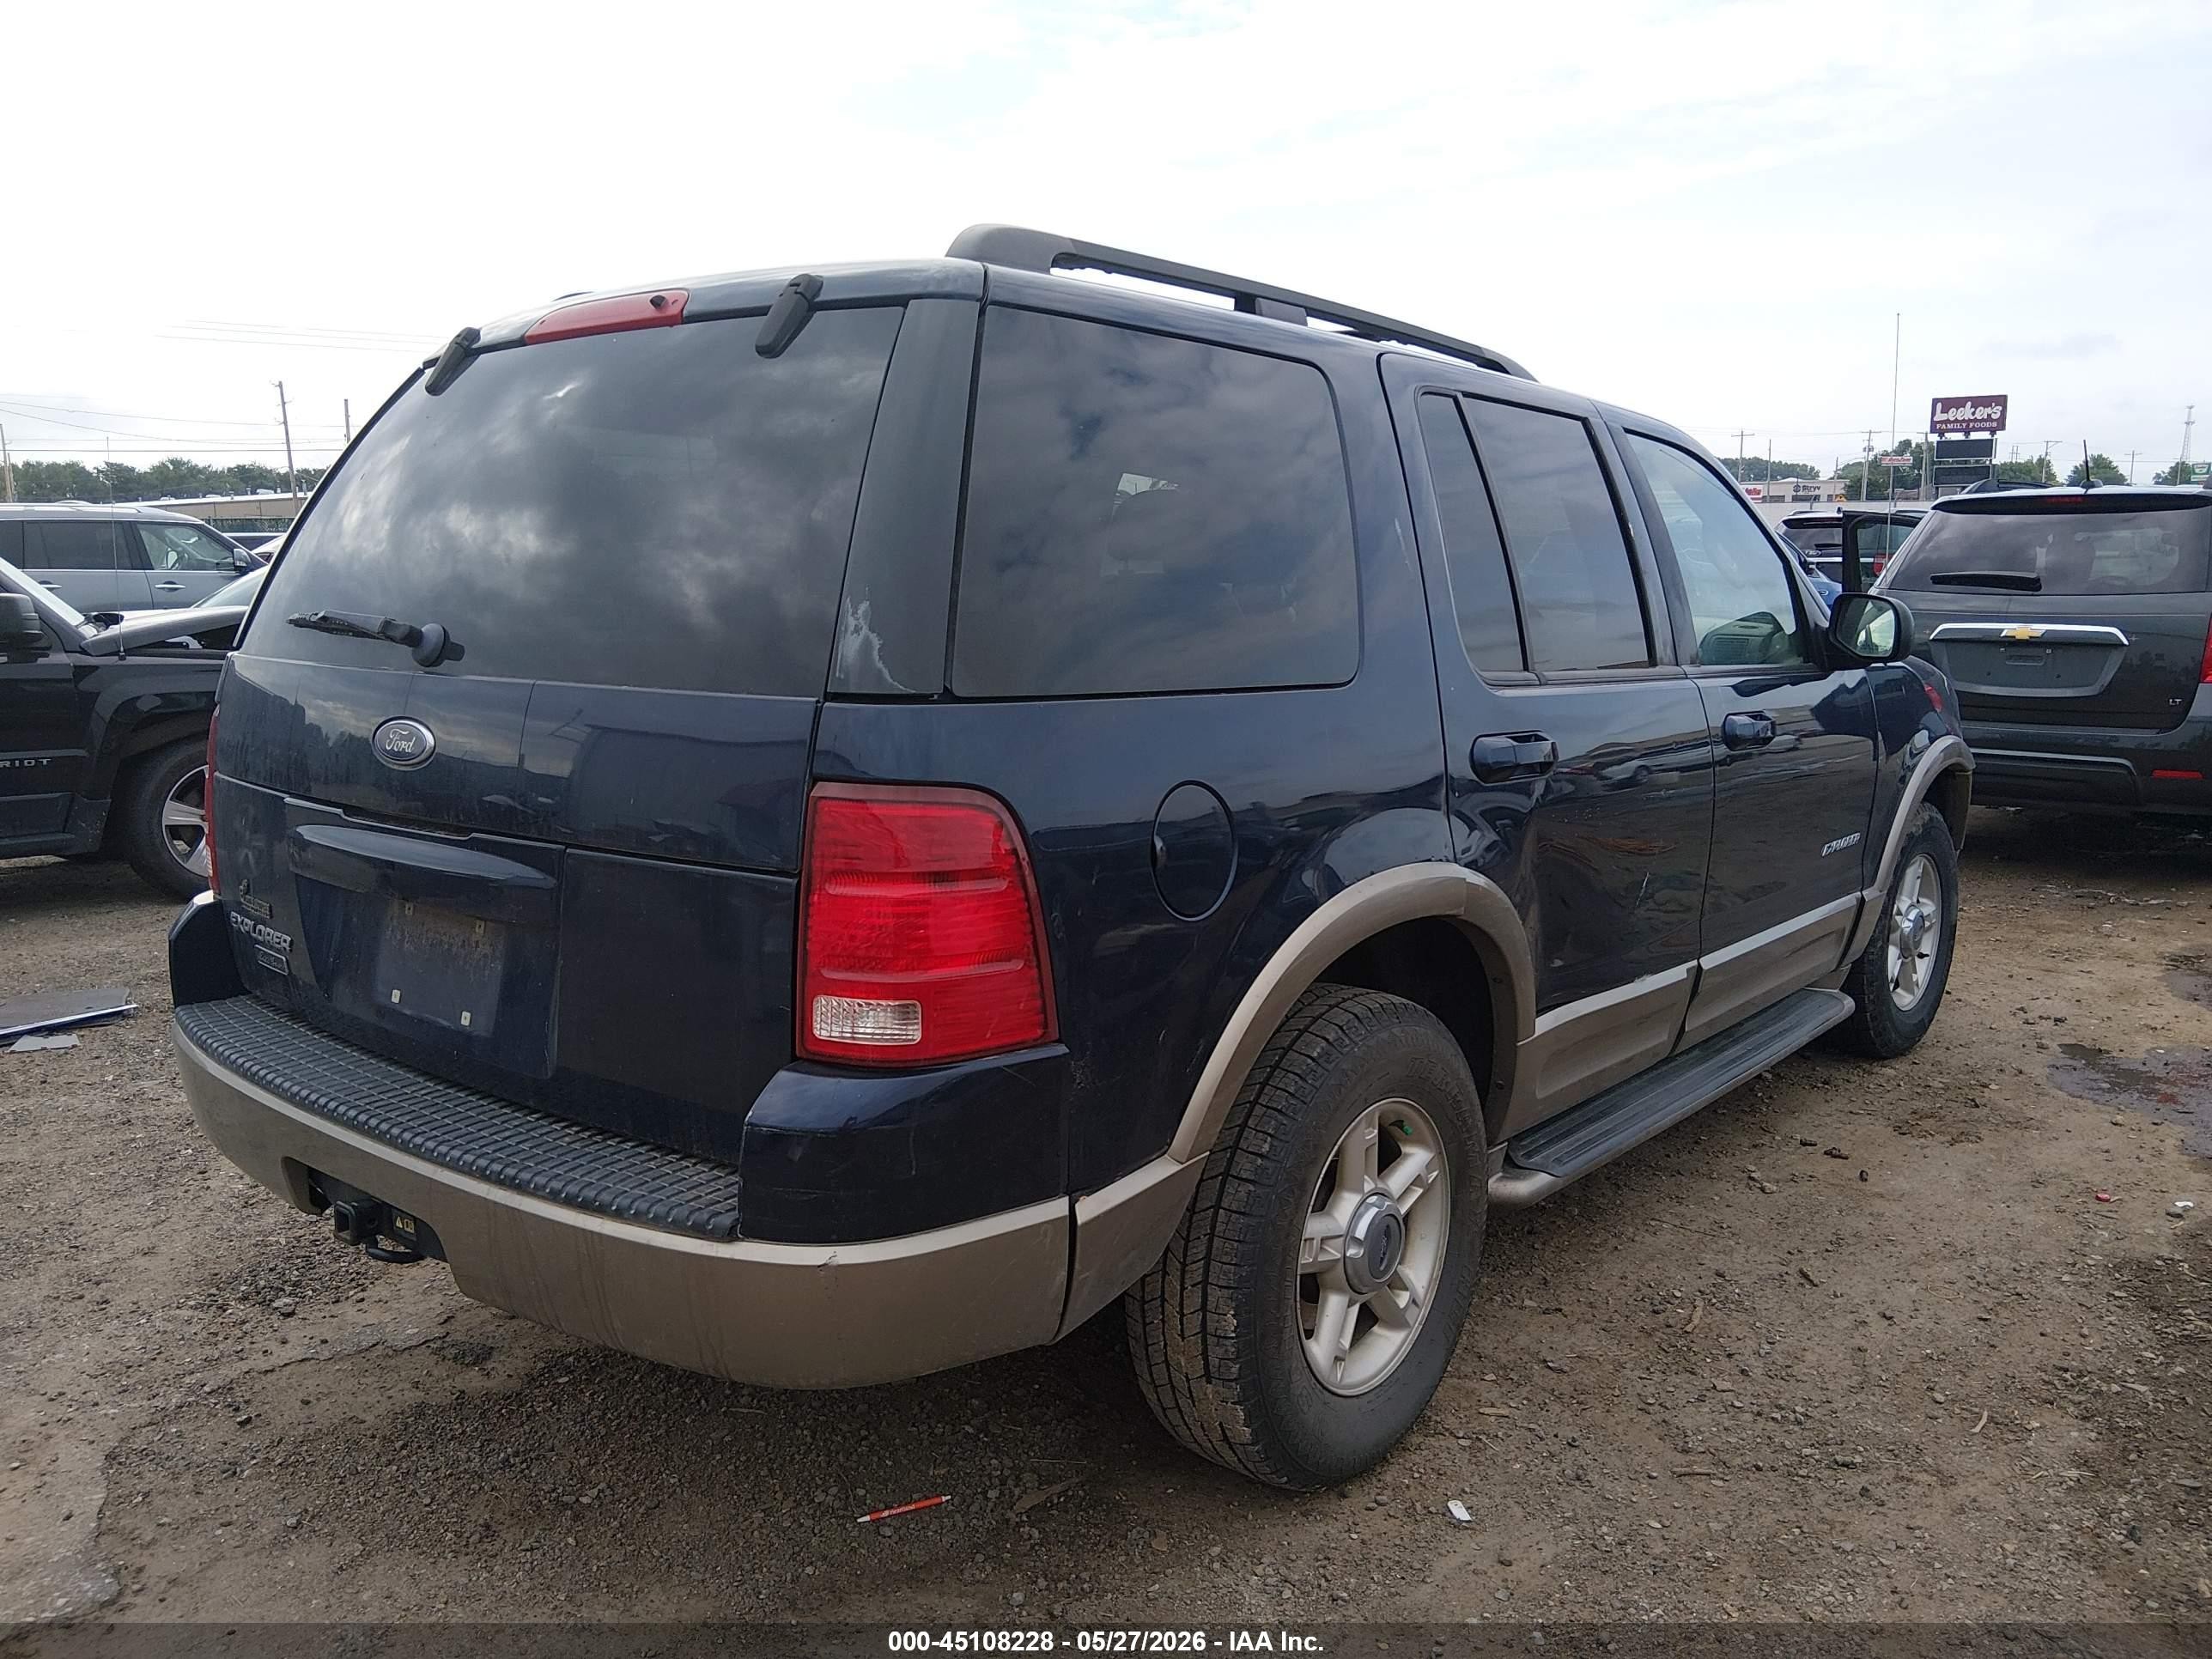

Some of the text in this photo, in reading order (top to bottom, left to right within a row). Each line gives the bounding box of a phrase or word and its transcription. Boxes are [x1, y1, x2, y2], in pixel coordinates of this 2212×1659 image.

[1933, 401, 2002, 421] Leeker's
[386, 728, 416, 753] Ford
[230, 911, 291, 952] EXPLORER
